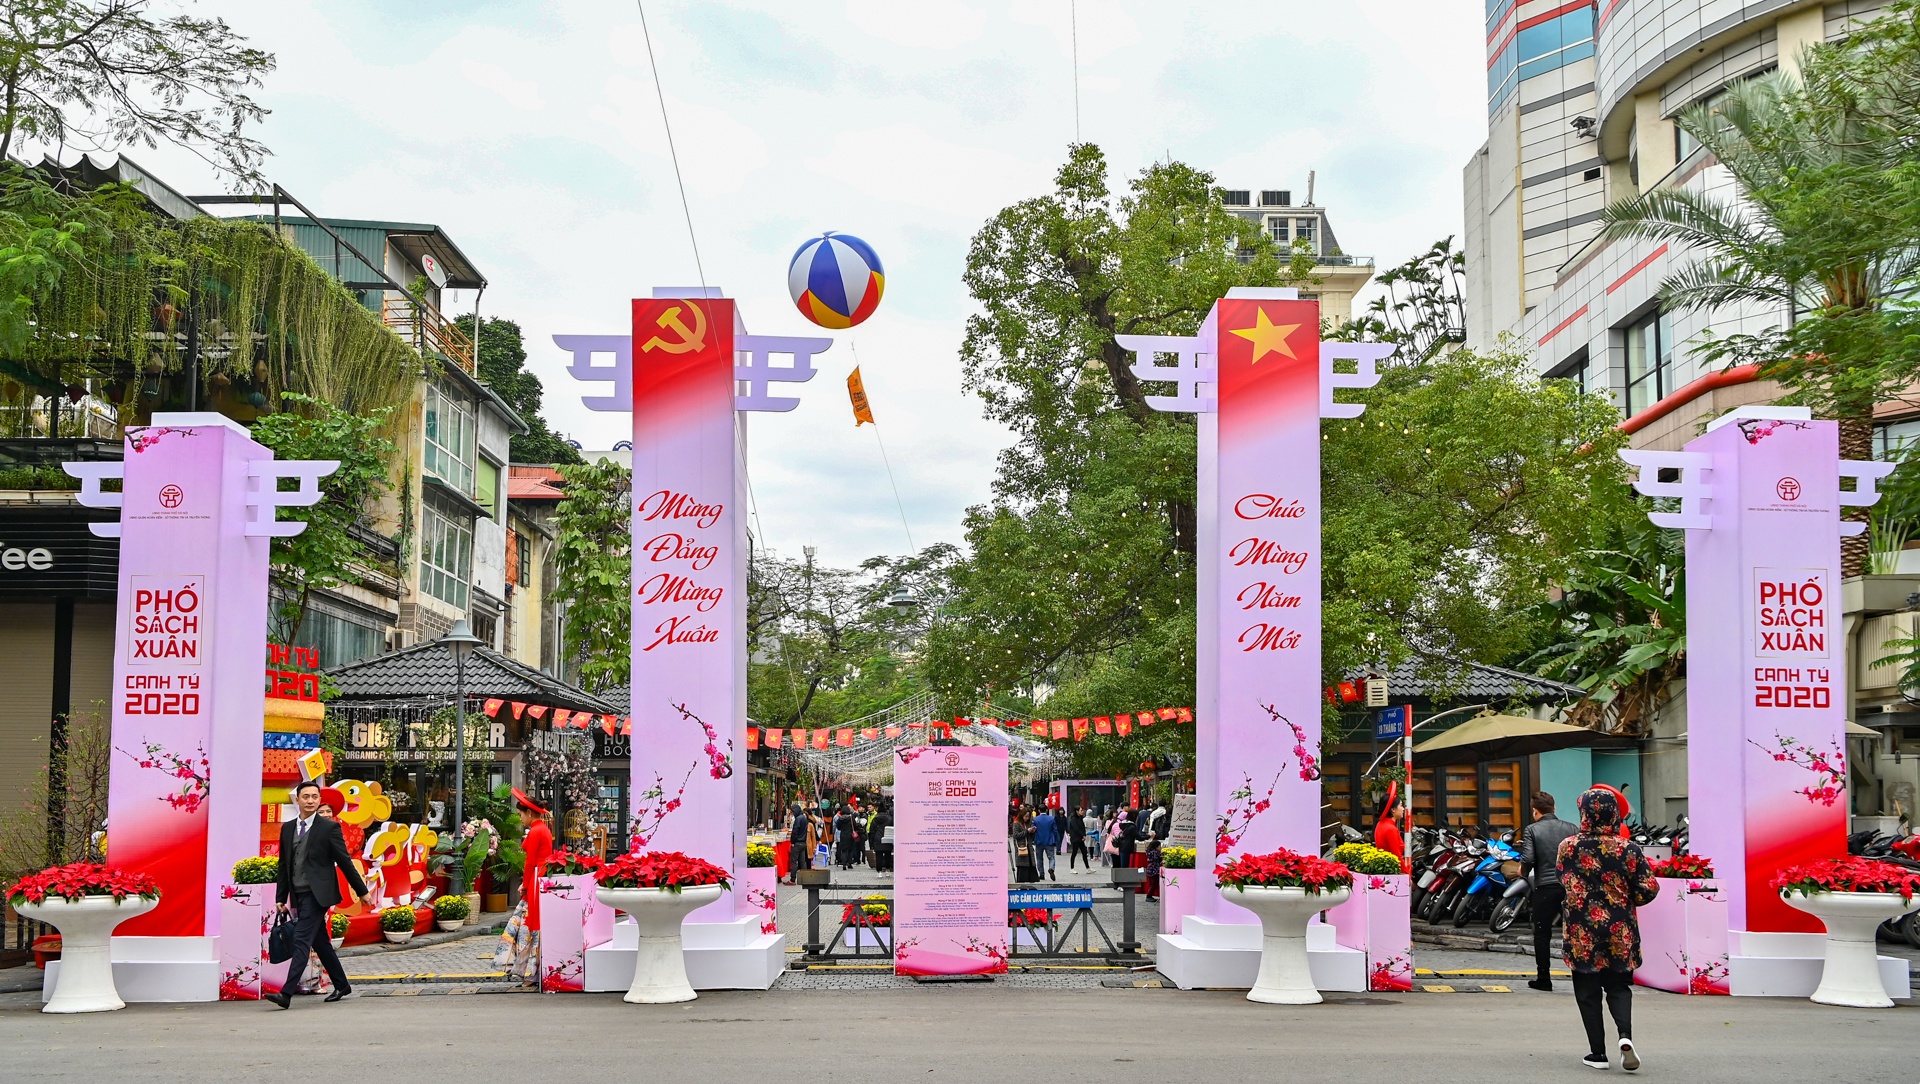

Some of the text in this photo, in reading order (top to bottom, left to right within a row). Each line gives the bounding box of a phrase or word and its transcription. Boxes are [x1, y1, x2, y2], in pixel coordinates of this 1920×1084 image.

[638, 490, 724, 529] Mừng
[1234, 493, 1306, 520] Chúc
[0, 541, 53, 570] ee
[643, 533, 719, 571] Đảng
[1228, 537, 1308, 575] Mừng
[135, 582, 198, 613] PHỐ
[637, 573, 724, 612] Mừng
[1236, 581, 1302, 610] Năm
[1760, 576, 1823, 606] PHỐ
[135, 611, 197, 634] SÁCH
[1760, 603, 1823, 627] SÁCH
[642, 615, 719, 652] Xuân
[1238, 623, 1302, 652] Mới
[1761, 628, 1824, 651] XUÂN
[133, 635, 196, 658] XUÂN
[126, 673, 200, 689] CANH TÝ
[1755, 666, 1829, 683] CANH TÝ
[125, 693, 200, 715] 2020
[1755, 686, 1830, 708] 2020
[1388, 709, 1397, 718] PHỐ
[1378, 722, 1402, 734] 19 THÁNG 12
[345, 750, 378, 760] ORGANIC
[379, 750, 409, 760] FLWER
[414, 750, 429, 760] GIFT
[945, 787, 976, 797] 2020
[1010, 892, 1091, 904] VỰC CẤM CÁC PHƯƠNG TIỆN ĐI VÀO
